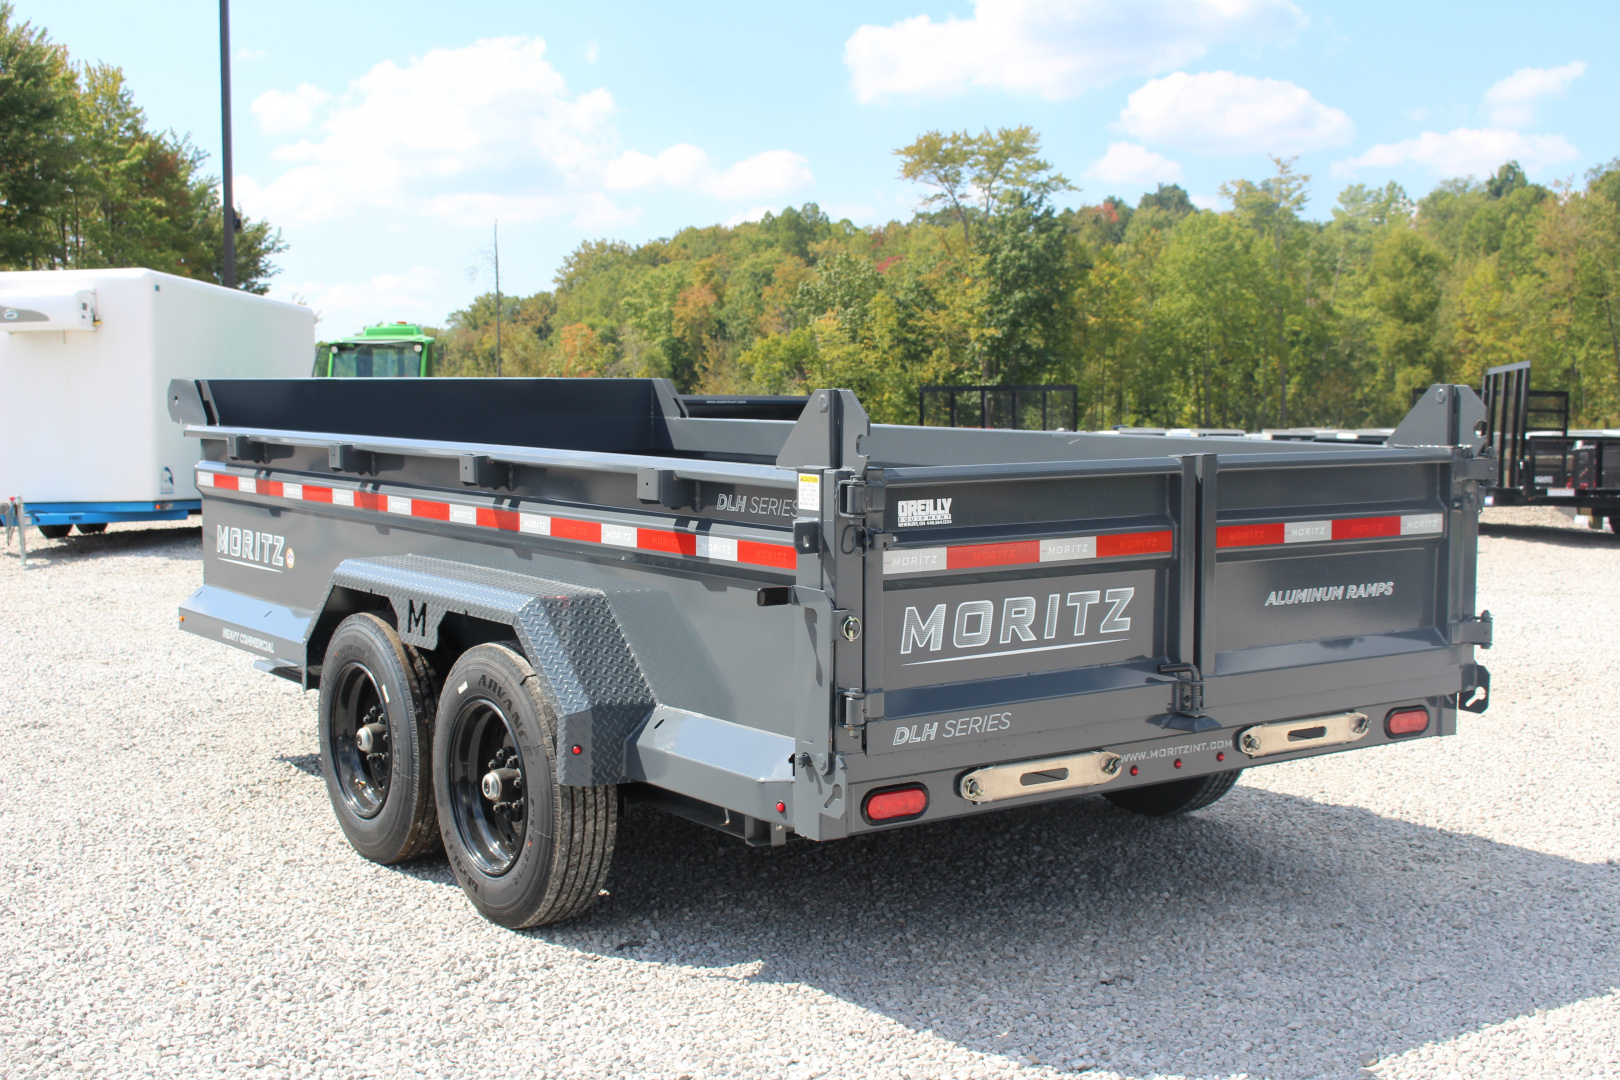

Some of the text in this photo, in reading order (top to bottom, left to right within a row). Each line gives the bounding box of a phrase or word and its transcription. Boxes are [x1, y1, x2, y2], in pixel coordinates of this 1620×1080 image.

[716, 493, 798, 517] DLH SERIES
[452, 510, 473, 520] MORITZ
[523, 519, 546, 530] MORITZ
[1406, 519, 1438, 529] MORITZ
[605, 530, 632, 541] MORITZ
[1290, 526, 1325, 537] MORITZ
[216, 524, 285, 567] MORITZ
[701, 542, 732, 554] MORITZ
[1047, 543, 1088, 555] MORITZ
[892, 554, 938, 567] MORITZ
[1265, 581, 1394, 607] ALUMINUM RAMPS
[900, 586, 1135, 655] MORITZ
[222, 627, 240, 642] HEAVY
[892, 711, 1012, 746] DLH SERIES
[1120, 739, 1233, 763] WWW.MORITZINT.COM
